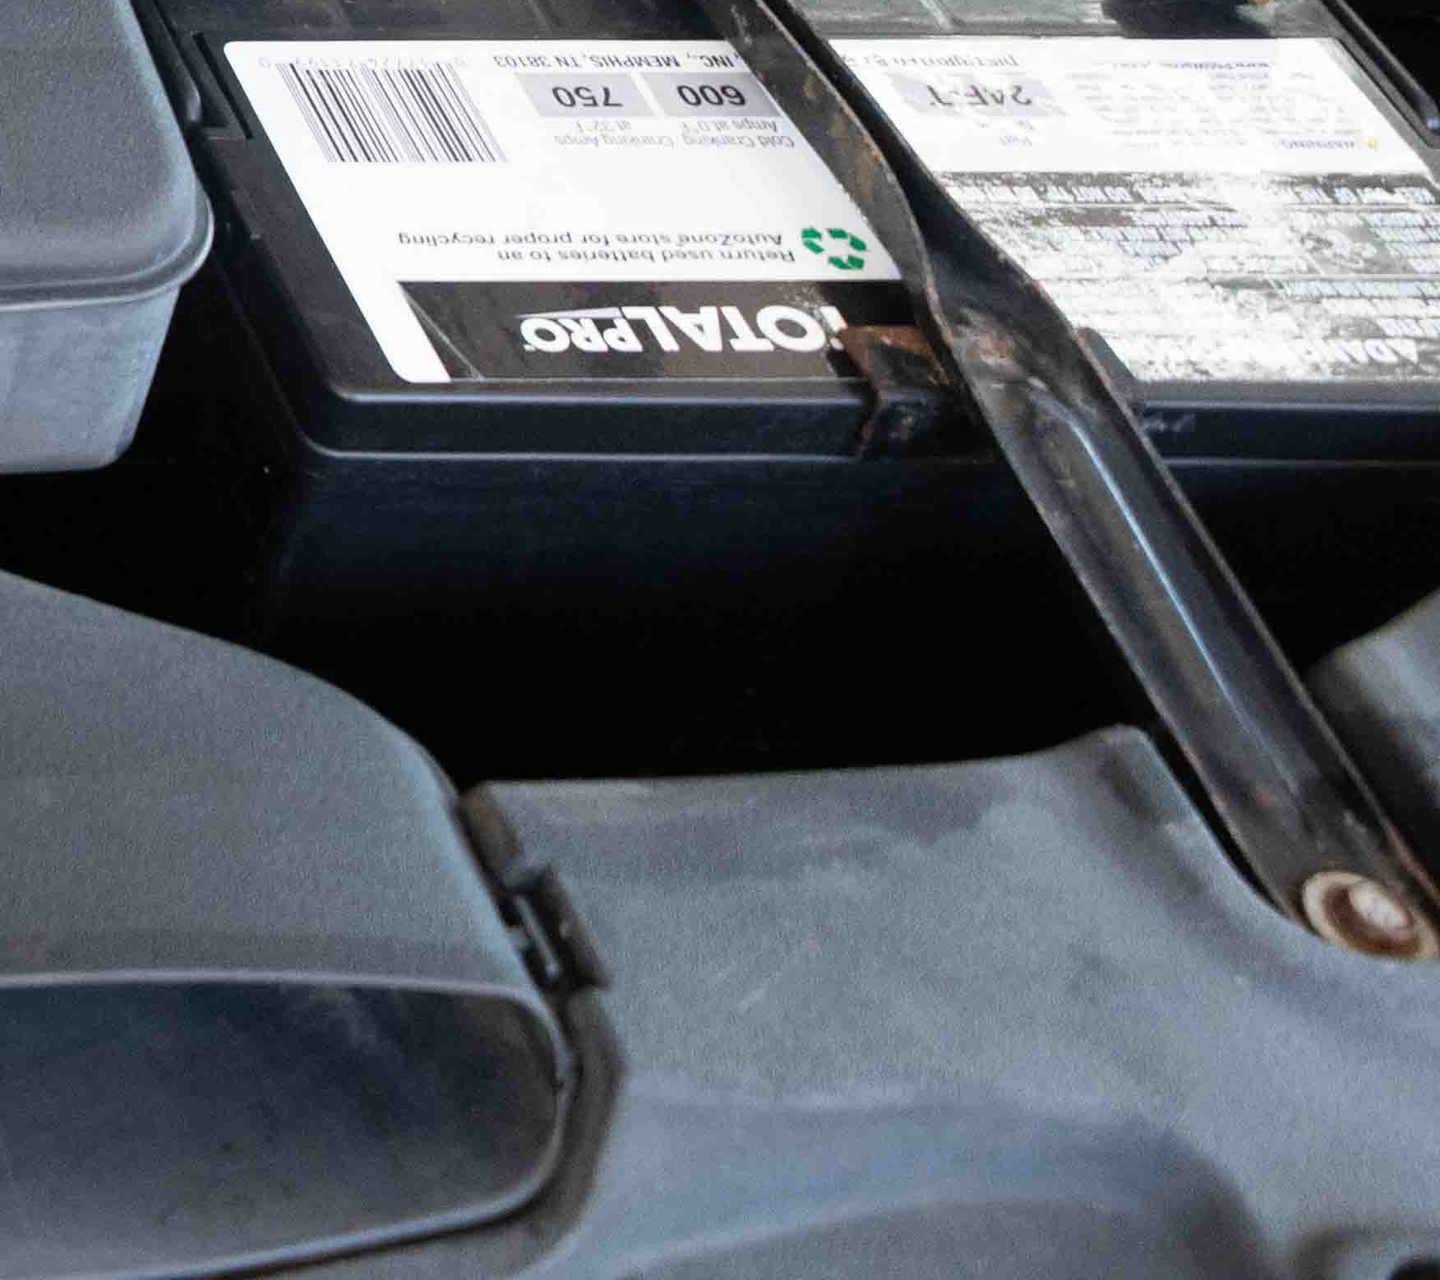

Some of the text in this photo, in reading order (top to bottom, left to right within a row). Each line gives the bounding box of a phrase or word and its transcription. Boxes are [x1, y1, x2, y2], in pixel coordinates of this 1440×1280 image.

[556, 55, 579, 68] TN
[583, 53, 680, 68] MEMPHIS,
[551, 85, 624, 108] 750
[677, 84, 747, 107] 600
[554, 134, 675, 149] Cranking Amps
[681, 134, 756, 149] Cranking
[398, 231, 496, 245] recycling
[504, 231, 573, 244] proper
[587, 233, 611, 246] for
[615, 233, 670, 245] store
[498, 249, 796, 263] Return used batteries to an
